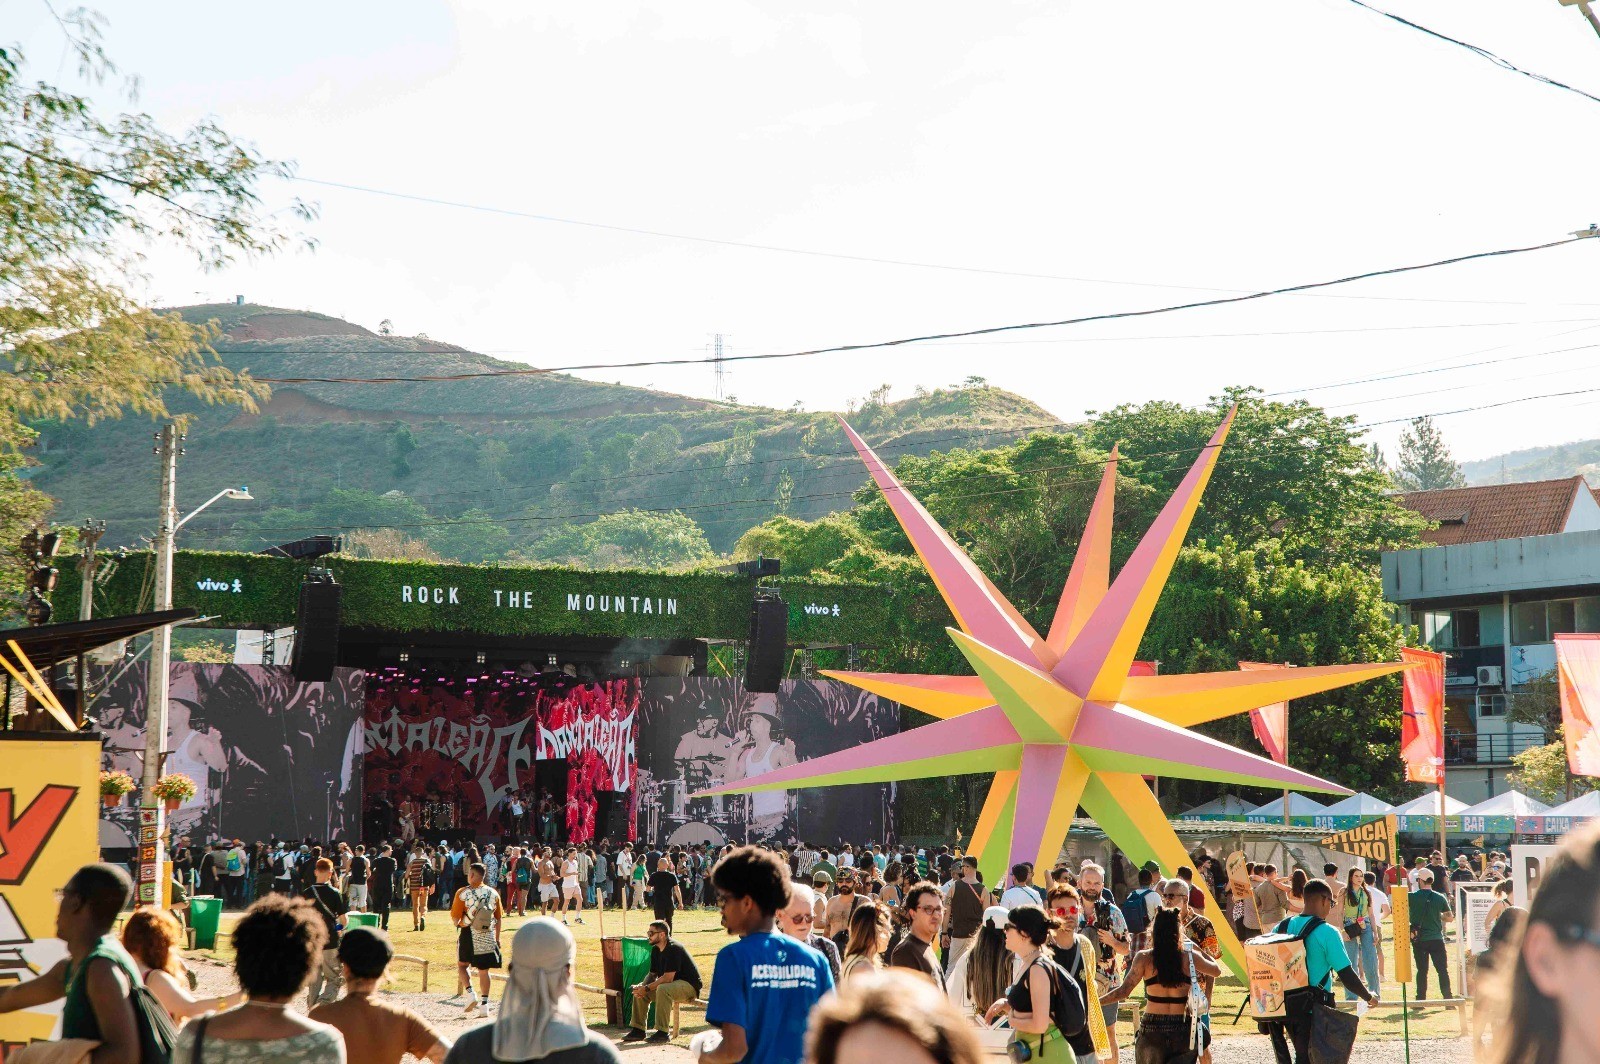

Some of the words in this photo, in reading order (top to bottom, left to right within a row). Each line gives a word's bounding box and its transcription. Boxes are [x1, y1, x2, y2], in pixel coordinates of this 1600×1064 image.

[196, 578, 229, 591] vivo
[402, 585, 460, 604] ROCK
[494, 590, 533, 609] THE
[567, 593, 677, 615] MOUNTAIN
[804, 603, 830, 615] vivo
[1464, 816, 1485, 832] BAR
[1545, 817, 1570, 833] CAIXA
[1321, 820, 1388, 845] BITUCA
[1343, 841, 1387, 862] LIXO
